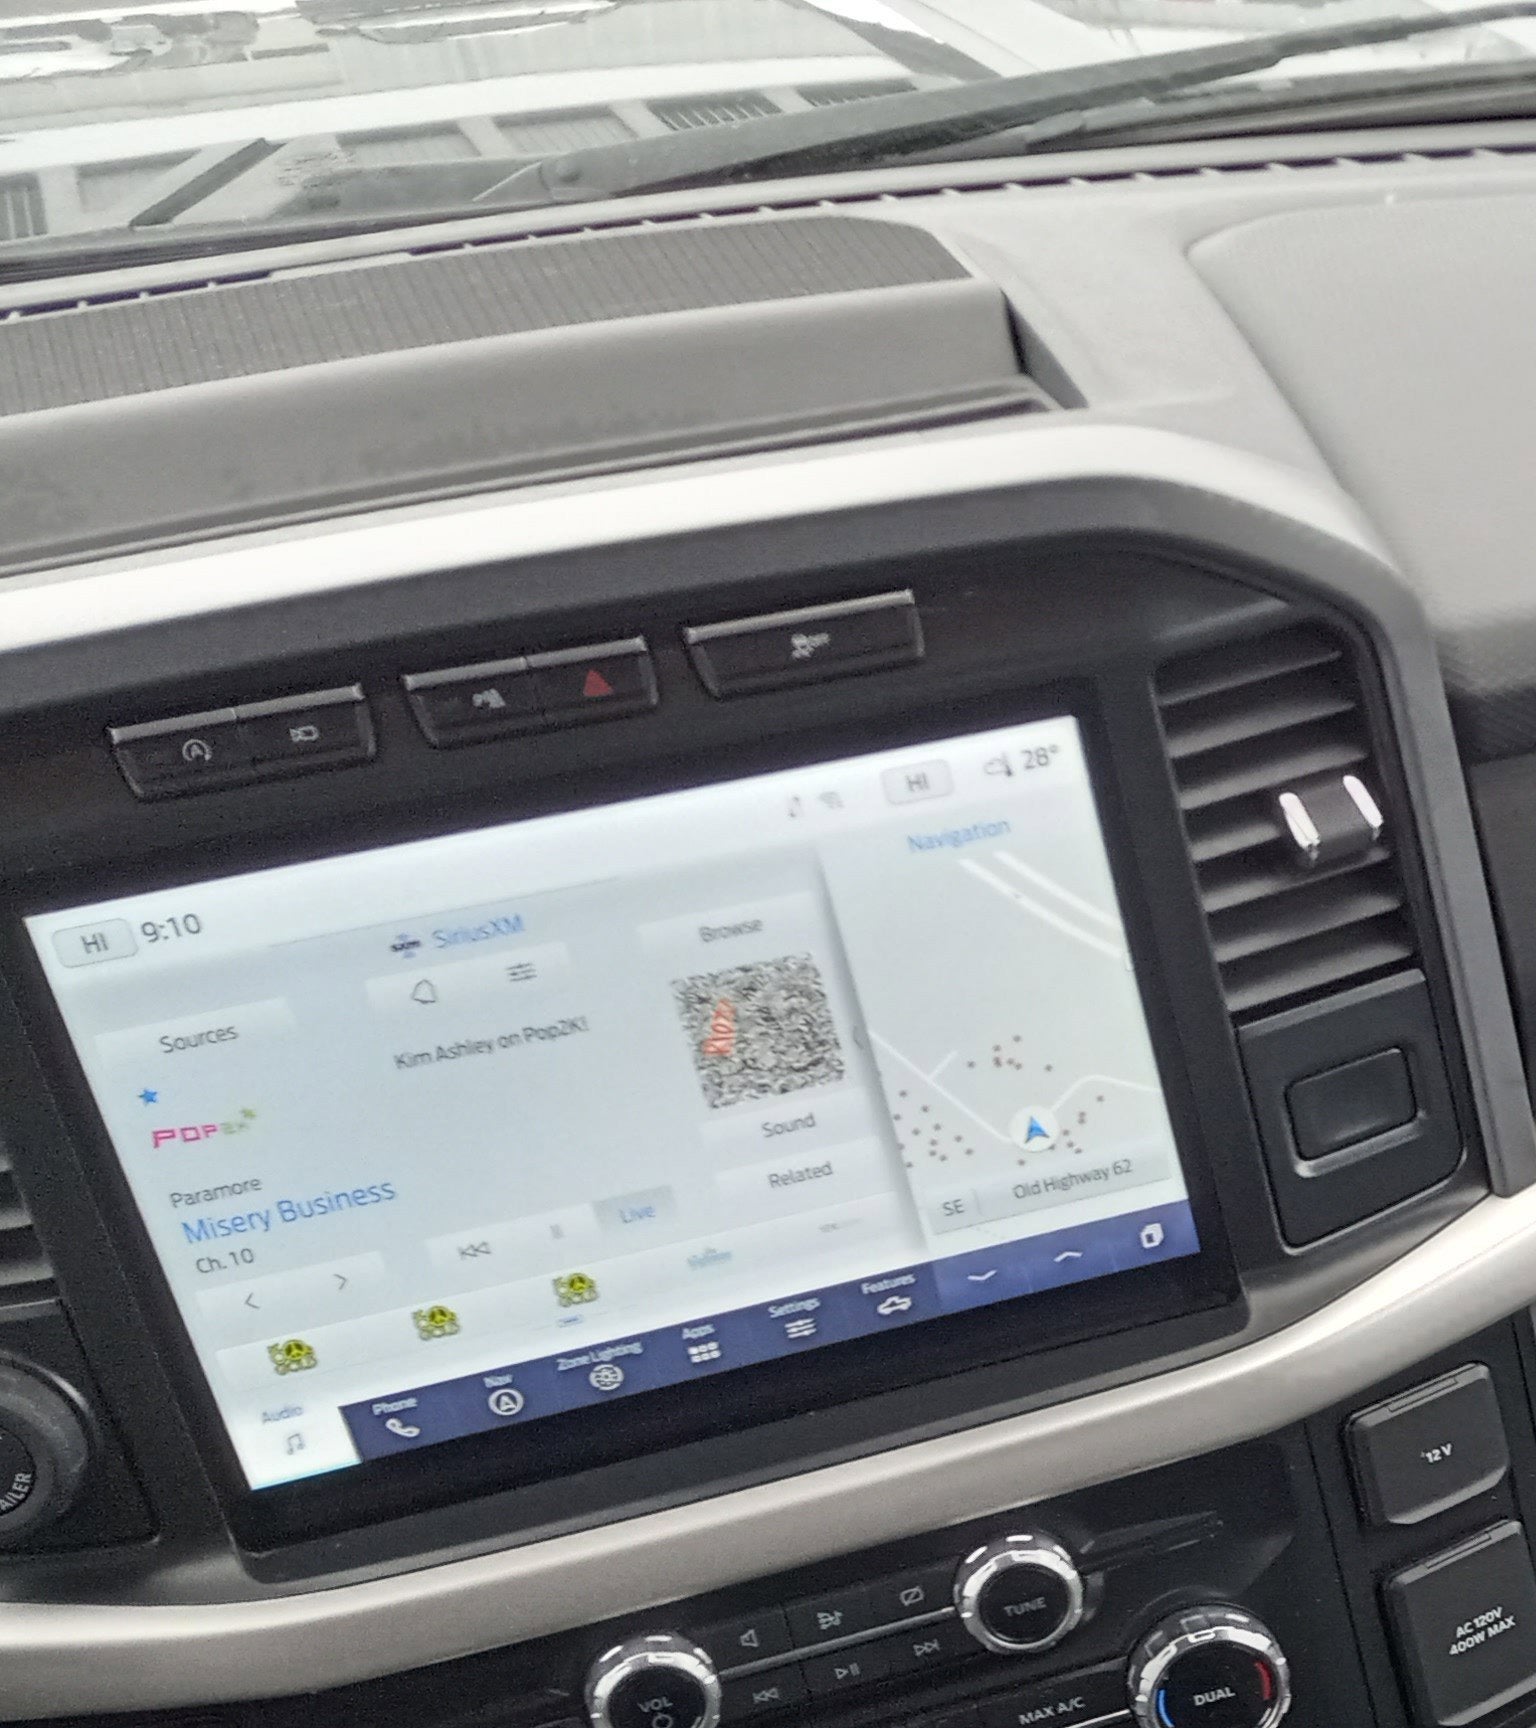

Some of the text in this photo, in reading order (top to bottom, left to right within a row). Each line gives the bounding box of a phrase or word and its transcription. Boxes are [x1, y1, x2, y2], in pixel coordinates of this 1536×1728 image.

[905, 772, 930, 794] HI
[906, 819, 1012, 853] Navigation
[141, 913, 203, 943] 9:10
[432, 914, 525, 949] SiriusXM
[699, 919, 764, 943] Browse
[81, 932, 109, 954] HI
[159, 1025, 240, 1054] Sources
[394, 1052, 433, 1070] Kim
[435, 1038, 494, 1061] Ashley
[497, 1033, 522, 1050] on
[761, 1113, 817, 1139] Sound
[767, 1160, 834, 1190] Related
[1013, 1158, 1133, 1200] Old Highway 62
[170, 1177, 263, 1209] Paramore
[181, 1182, 397, 1244] Misery Business
[941, 1199, 966, 1217] SE
[196, 1247, 256, 1275] Ch. 10
[860, 1272, 917, 1295] Features
[768, 1297, 821, 1321] Settings
[261, 1405, 304, 1425] Audio
[1003, 1597, 1047, 1617] TUNE
[1449, 1615, 1517, 1656] 400W MAX
[1455, 1605, 1504, 1639] AC 120V
[636, 1696, 674, 1714] VOL
[1193, 1686, 1236, 1707] DUAL
[1018, 1696, 1087, 1726] MAX A/C
